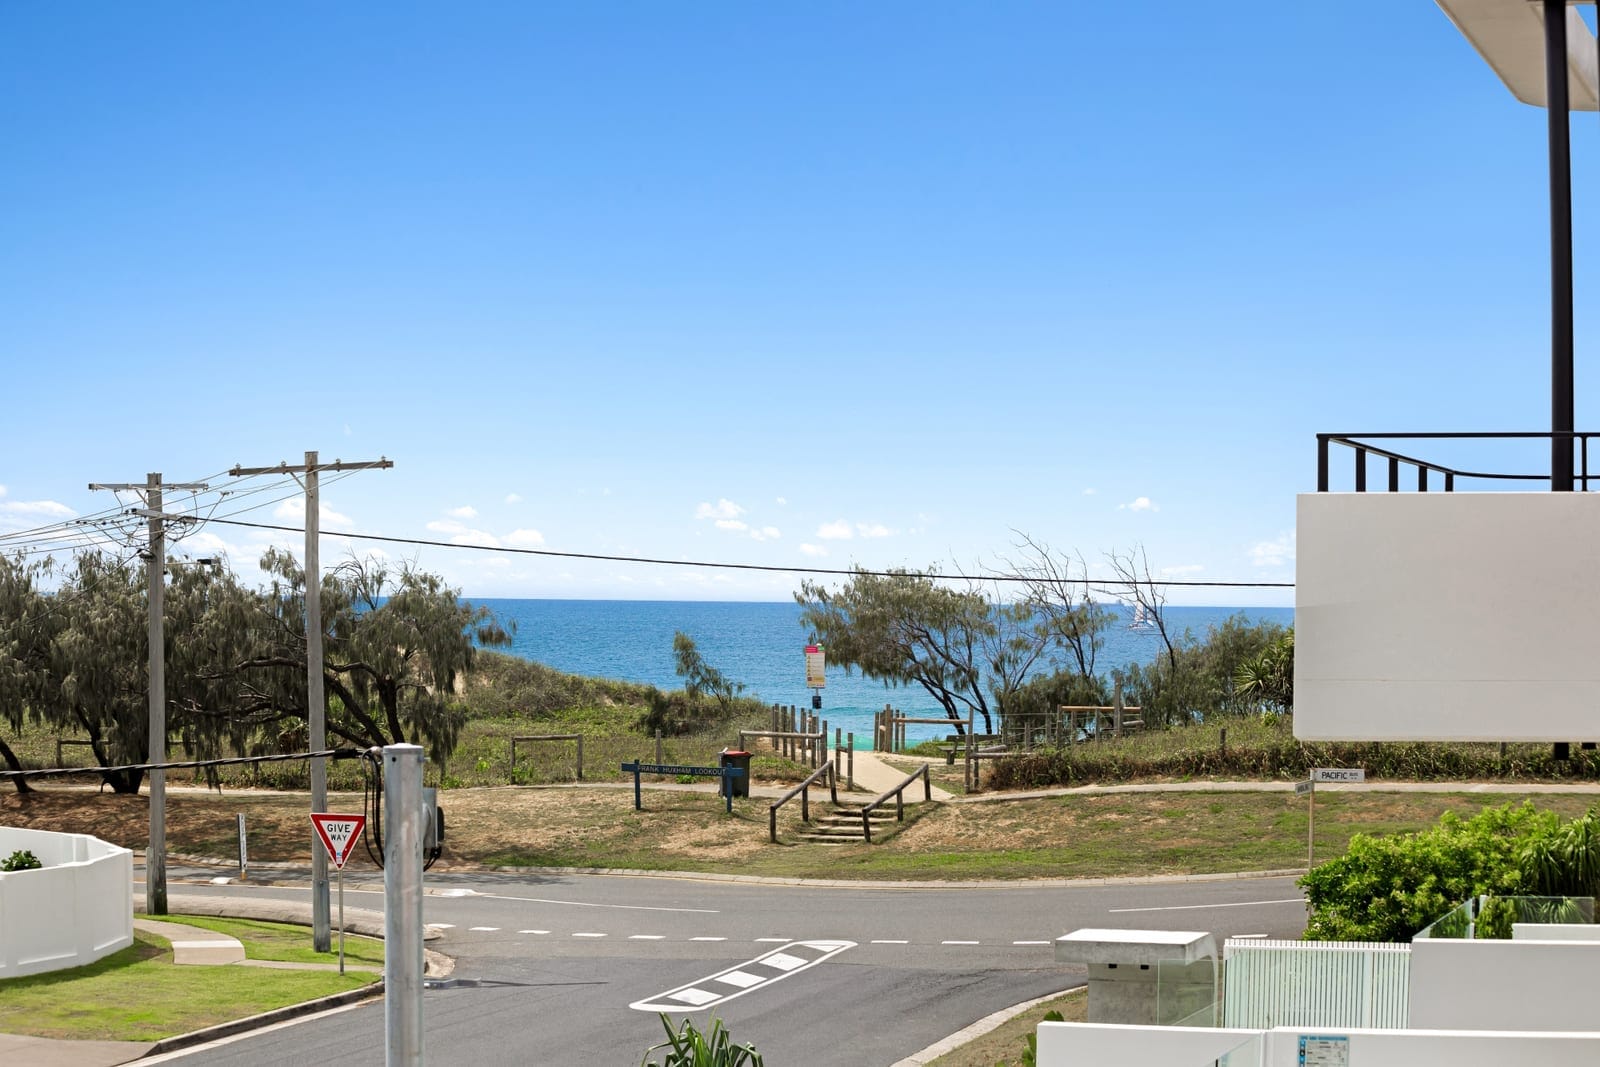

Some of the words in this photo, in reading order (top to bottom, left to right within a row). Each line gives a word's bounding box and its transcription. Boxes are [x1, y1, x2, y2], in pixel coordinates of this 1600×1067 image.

[662, 766, 691, 774] HUXHAM
[1321, 771, 1348, 780] PACIFIC
[327, 823, 351, 833] GIVE
